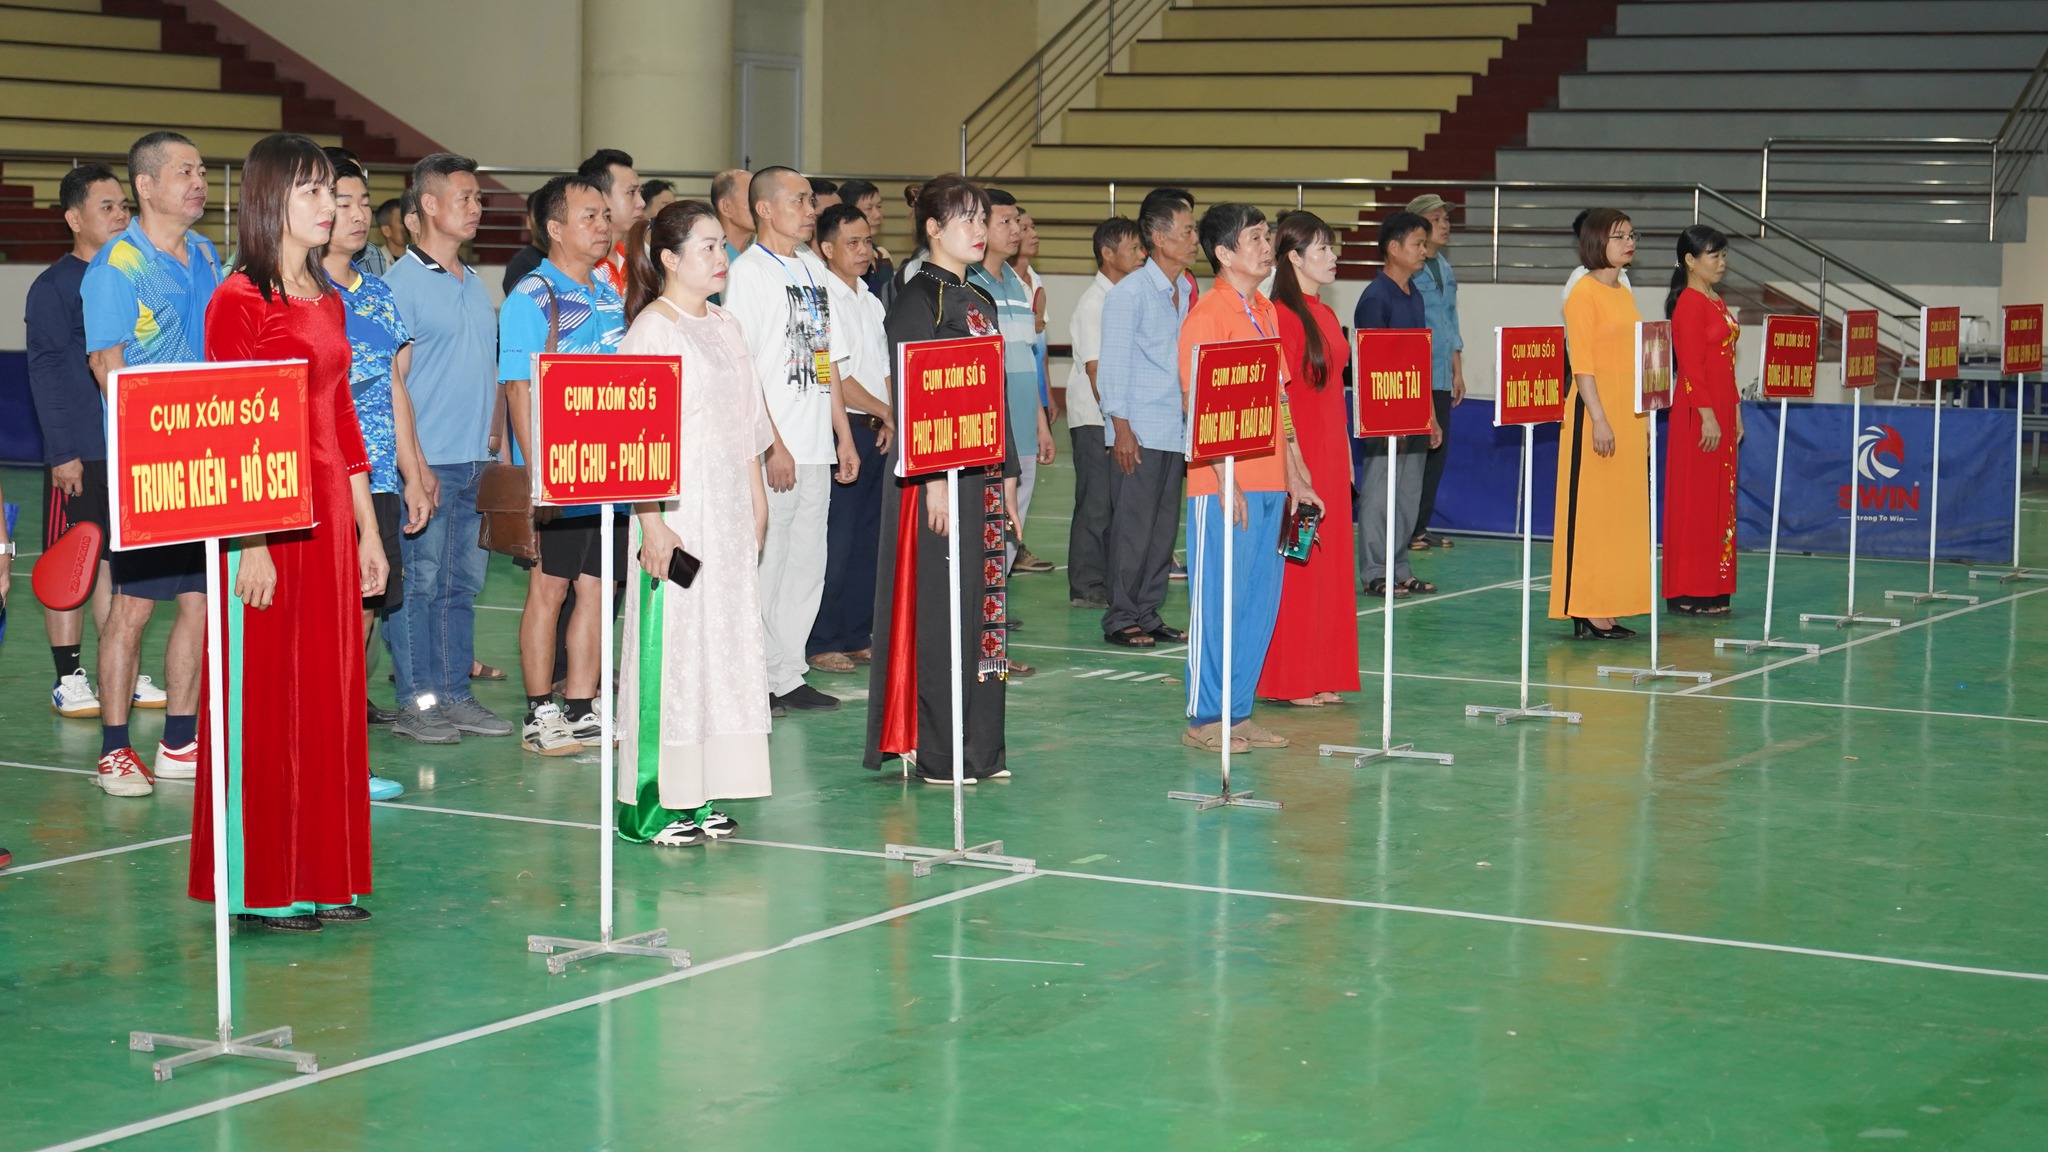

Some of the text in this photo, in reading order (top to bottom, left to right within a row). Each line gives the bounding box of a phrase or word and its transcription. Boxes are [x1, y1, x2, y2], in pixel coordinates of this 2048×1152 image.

[1512, 338, 1555, 361] CỤM XÓM SỐ 8
[1797, 330, 1804, 347] SỐ
[1805, 335, 1810, 348] 12
[923, 358, 986, 395] CỤM XÓM SỐ 6
[1212, 358, 1266, 390] CỤM XÓM SỐ 7
[1371, 365, 1420, 406] TRỌNG TÀI
[1507, 375, 1517, 408] TÂN
[1518, 371, 1529, 407] TIẾN
[1534, 370, 1544, 406] CỐC
[1546, 373, 1559, 405] LÙNG
[150, 387, 279, 435] CỤM XÓM SỐ 4
[565, 379, 656, 416] CỤM XÓM SỐ 5
[913, 413, 932, 455] PHÚC
[934, 411, 953, 452] XUÂN
[959, 413, 981, 449] TRUNG
[983, 405, 997, 452] VIỆT
[1219, 404, 1235, 442] MÀN
[1240, 397, 1258, 439] KHẤU
[1259, 396, 1272, 436] BẢO
[132, 438, 298, 513] TRUNG KIÊN - HỒ SEN
[550, 440, 577, 492] CHỢ
[581, 444, 606, 483] CHU
[620, 429, 645, 481] PHỐ
[649, 434, 670, 480] NÚI
[1839, 484, 1919, 511] SWIN
